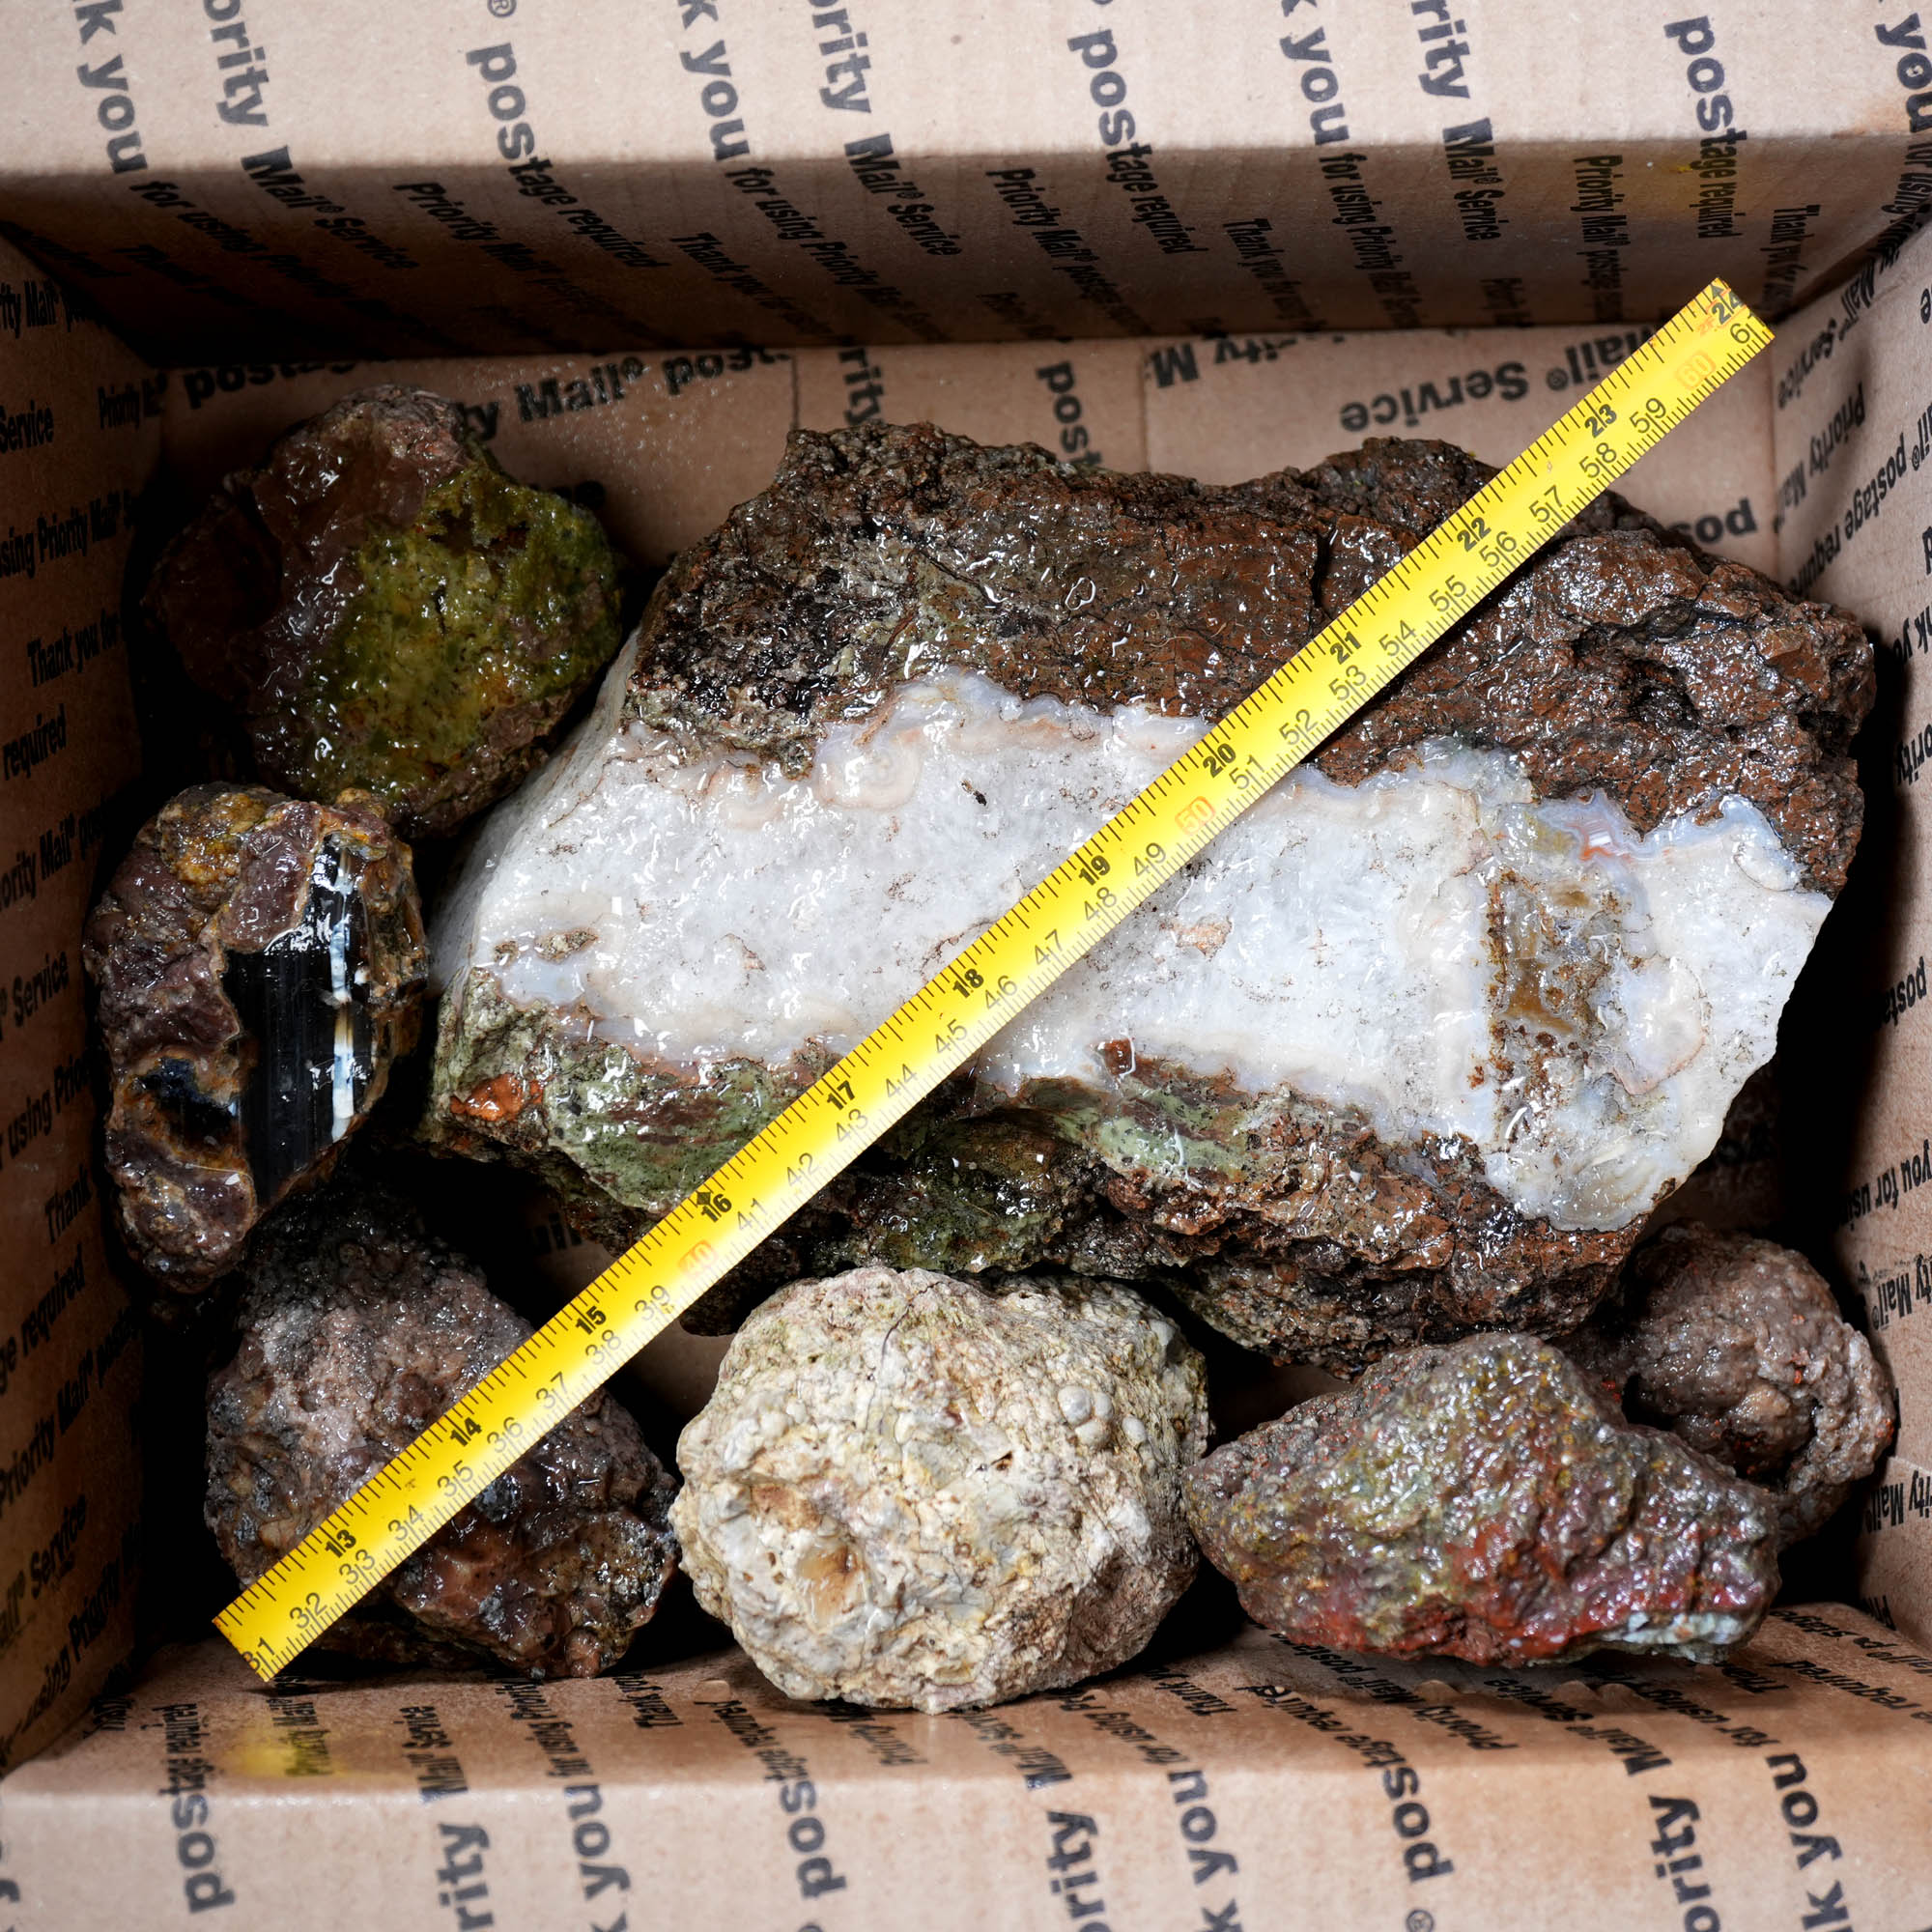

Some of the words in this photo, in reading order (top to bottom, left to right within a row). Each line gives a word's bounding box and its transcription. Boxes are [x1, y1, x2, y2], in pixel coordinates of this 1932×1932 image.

[1280, 26, 1350, 146] you
[1663, 15, 1747, 180] postage
[76, 54, 148, 174] you
[129, 181, 196, 209] for
[466, 42, 579, 207] postage
[557, 209, 672, 269] required
[679, 40, 751, 161] you
[724, 167, 781, 195] for
[754, 199, 825, 241] using
[810, 0, 872, 114] rity
[887, 203, 962, 256] Service
[1066, 29, 1159, 192] postage
[1129, 195, 1209, 254] required
[984, 167, 1062, 226] Priority
[1319, 153, 1368, 181] for
[1570, 154, 1626, 212] Priority
[392, 182, 502, 242] Priority
[1329, 184, 1382, 224] using
[1453, 188, 1510, 241] Service
[1689, 182, 1747, 239] required
[315, 217, 419, 270] Service
[669, 232, 752, 273] Thank
[1223, 217, 1286, 259] Thank
[1346, 226, 1404, 270] Priority
[1340, 361, 1530, 432] Service
[1809, 381, 1866, 477] Priority
[1845, 432, 1907, 540] postage
[3, 702, 68, 781] required
[12, 951, 70, 1028] Service
[325, 1529, 356, 1558] 13
[450, 1417, 482, 1447] 14
[575, 1305, 607, 1335] 15
[701, 1194, 732, 1223] 16
[827, 1080, 856, 1110] 17
[952, 968, 984, 999] 18
[1078, 855, 1111, 886] 19
[1203, 743, 1236, 779] 20
[1329, 631, 1361, 665] 21
[1457, 516, 1492, 553] 22
[1584, 404, 1617, 439] 23
[242, 1637, 275, 1671] 31
[289, 1592, 327, 1630] 32
[339, 1548, 376, 1585] 33
[387, 1504, 423, 1542] 34
[437, 1460, 473, 1498] 35
[487, 1417, 524, 1454] 36
[535, 1371, 568, 1409] 37
[584, 1329, 622, 1366] 38
[634, 1285, 670, 1321] 39
[737, 1198, 768, 1231] 41
[786, 1152, 819, 1187] 42
[836, 1108, 868, 1144] 43
[885, 1064, 918, 1099] 44
[934, 1018, 968, 1055] 45
[984, 975, 1018, 1010] 46
[1034, 929, 1064, 966] 47
[1083, 887, 1118, 922] 48
[1133, 842, 1166, 878] 49
[1179, 799, 1212, 834] 50
[1229, 754, 1265, 790] 51
[1278, 708, 1319, 745] 52
[1328, 665, 1366, 701] 53
[1378, 619, 1416, 657] 54
[1428, 574, 1466, 612] 55
[1478, 530, 1517, 568] 56
[1528, 485, 1564, 524] 57
[1578, 442, 1617, 479] 58
[1629, 397, 1666, 434] 59
[8, 1089, 52, 1158] using
[1875, 1167, 1899, 1209] for
[21, 1243, 85, 1357] required
[617, 1693, 684, 1729] Thank
[1155, 1681, 1237, 1717] Thank
[1483, 1678, 1595, 1722] Service
[1637, 1689, 1731, 1724] using
[1768, 1660, 1922, 1710] required
[526, 1721, 580, 1754] using
[694, 1699, 781, 1747] required
[1084, 1712, 1158, 1743] using
[1413, 1705, 1520, 1750] Priority
[1715, 1726, 1781, 1747] for
[1136, 1745, 1190, 1764] for
[754, 1749, 847, 1899] postage
[1167, 1770, 1239, 1885] you
[1334, 1734, 1455, 1883] postage
[1765, 1752, 1843, 1871] you
[563, 1784, 631, 1901] you
